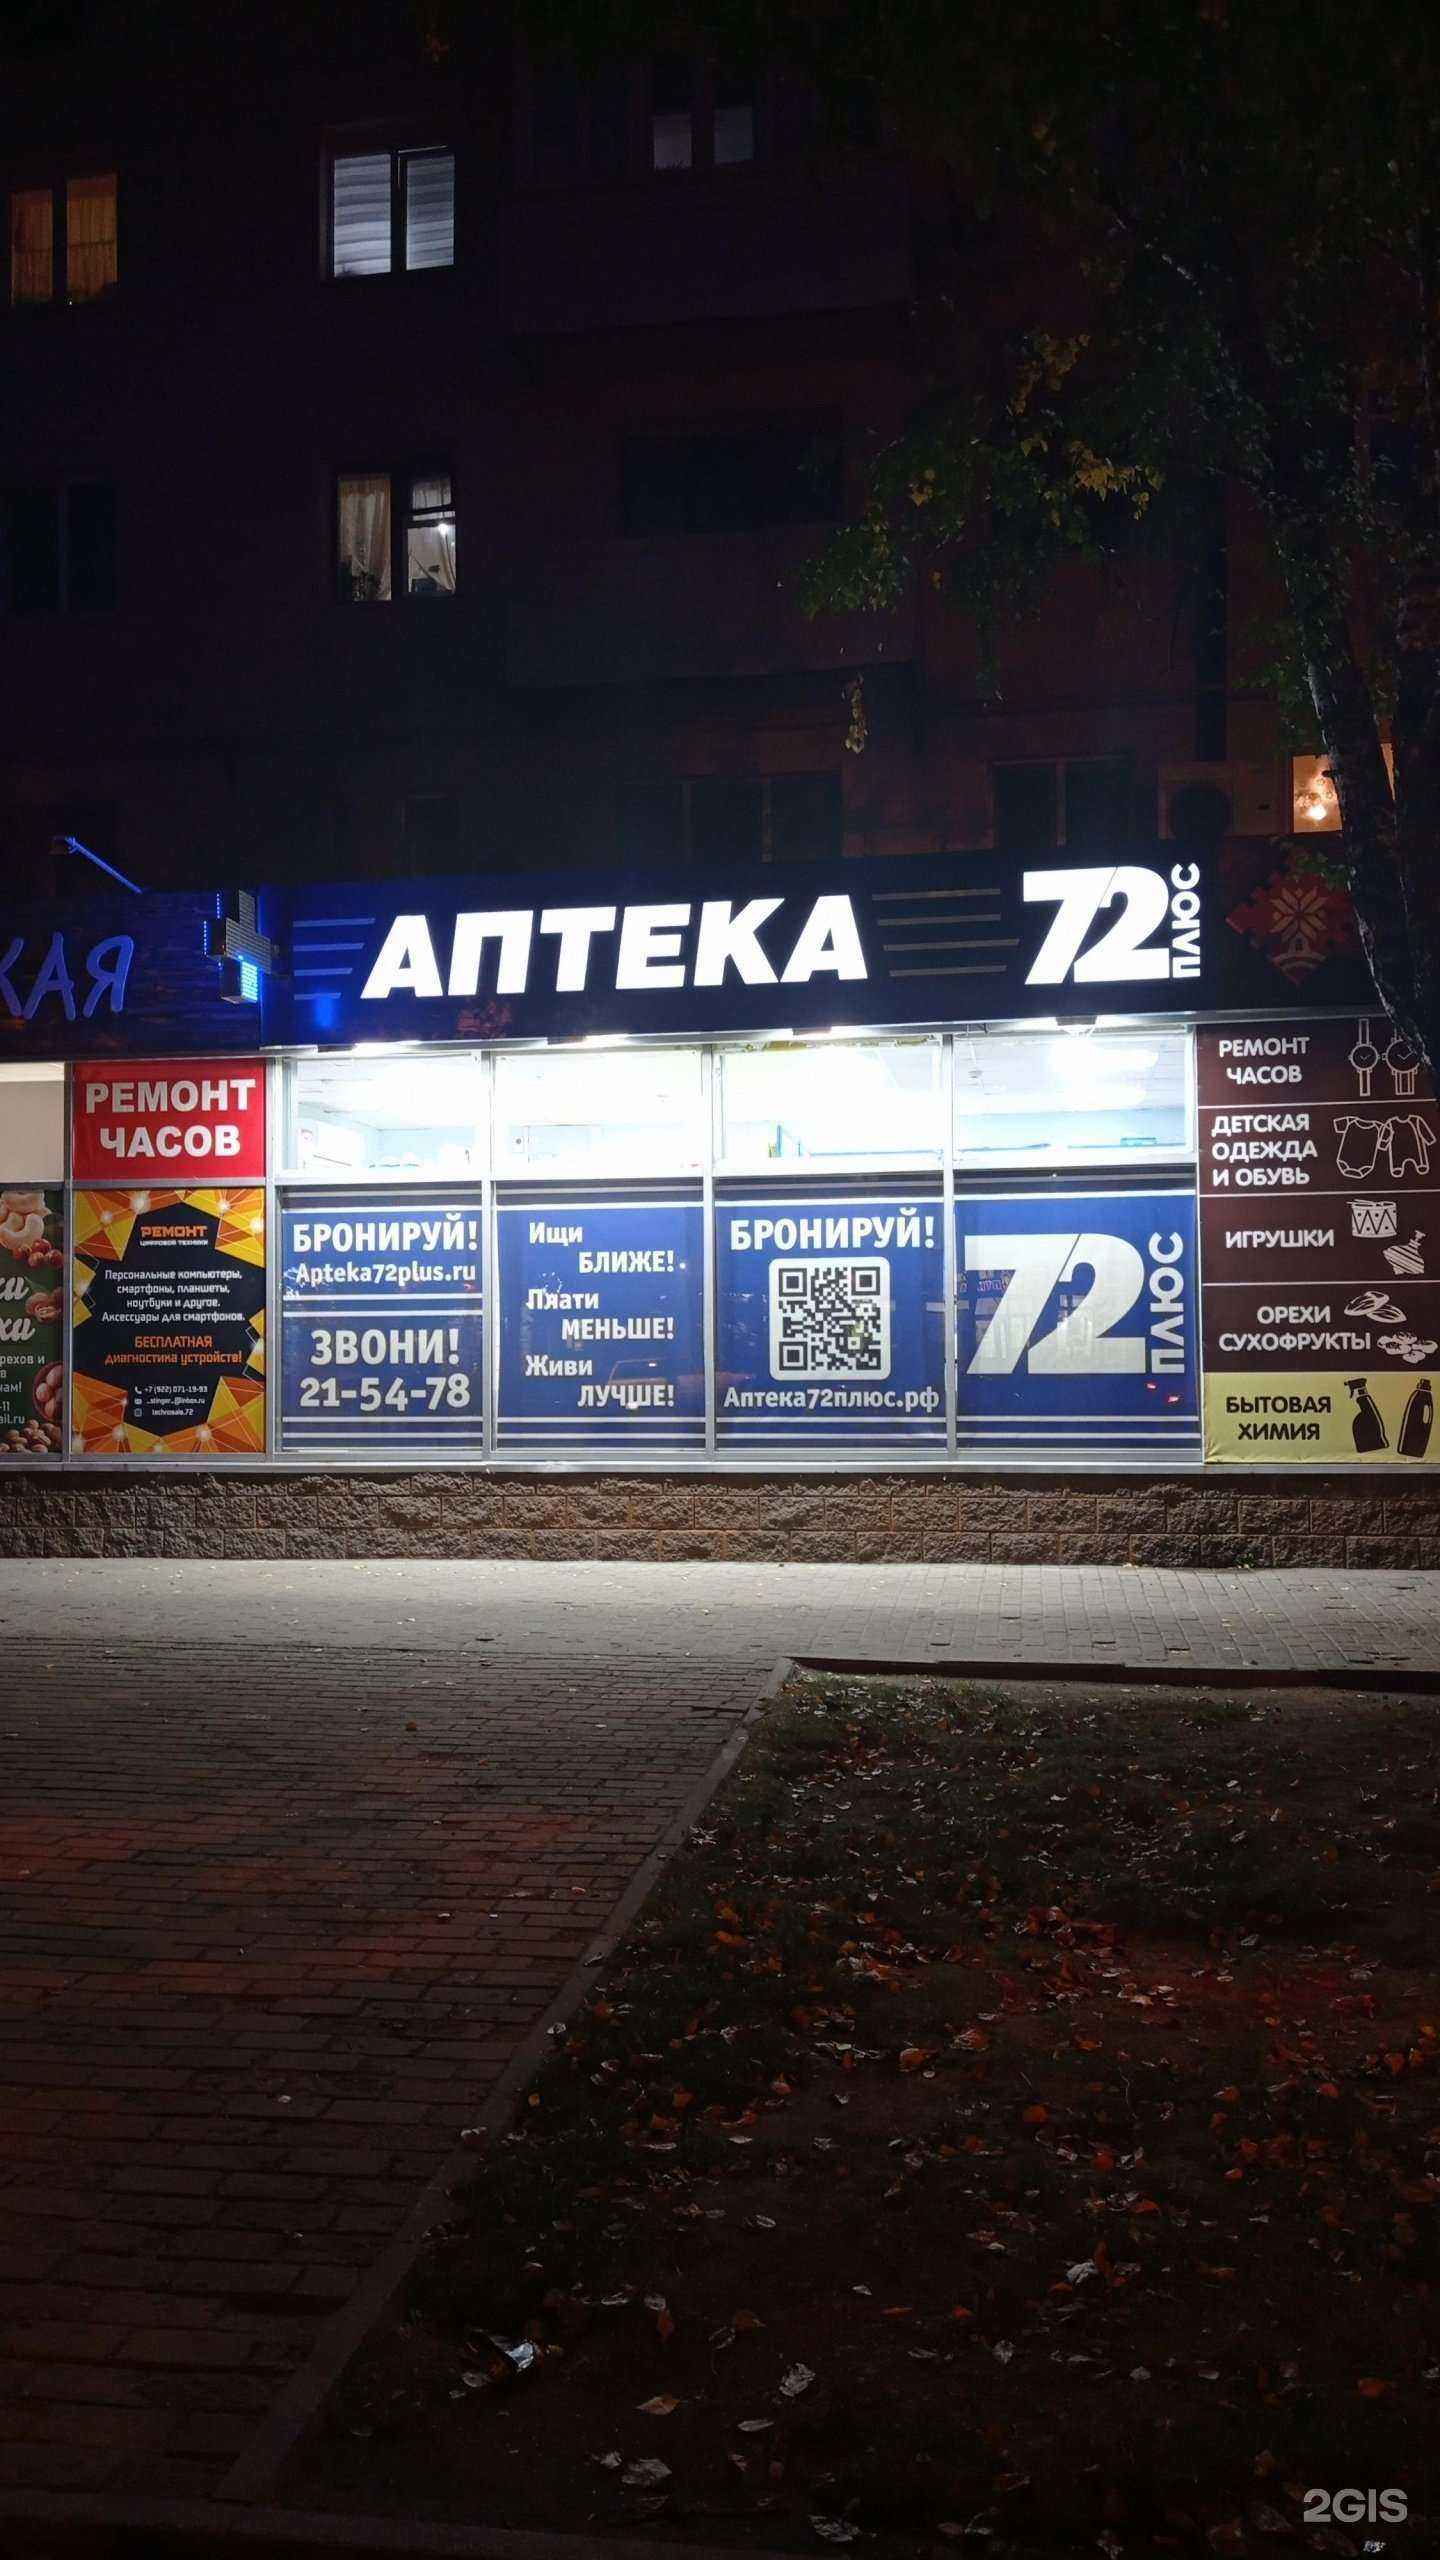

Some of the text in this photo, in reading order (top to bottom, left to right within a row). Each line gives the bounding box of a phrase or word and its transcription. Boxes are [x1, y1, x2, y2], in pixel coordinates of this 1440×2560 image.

[1171, 862, 1200, 978] ПЛЮС
[360, 866, 1170, 999] АПТЕКА 72
[1219, 1037, 1310, 1057] РЕМОНТ
[1226, 1065, 1303, 1085] ЧАСОВ
[86, 1079, 256, 1114] РЕМОНТ
[1211, 1113, 1310, 1137] ДЕТСКАЯ
[101, 1125, 241, 1158] ЧАСОВ
[1211, 1140, 1318, 1163] ОДЕЖДА
[1212, 1167, 1310, 1187] И ОБУВЬ
[140, 1226, 208, 1238] РЕМОНТ
[293, 1212, 478, 1252] БРОНИРУЙ!
[529, 1222, 583, 1246] Ищи
[730, 1207, 935, 1251] БРОНИРУЙ!
[1225, 1229, 1335, 1249] ИГРУШКИ
[578, 1250, 674, 1274] БЛИЖЕ!
[105, 1269, 242, 1281] Персональные компьютеры,
[295, 1261, 476, 1287] Apteka72plus.ru
[117, 1284, 230, 1295] смартфоны, планшеты,
[126, 1298, 172, 1310] ноутбуки
[183, 1300, 221, 1310] другое.
[965, 1233, 1146, 1374] 72
[1149, 1231, 1185, 1374] ПЛЮС
[102, 1312, 245, 1324] Аксессуары для смартфонов.
[1256, 1306, 1331, 1324] ОРЕХИ
[562, 1317, 674, 1340] МЕНЬШЕ!
[134, 1336, 213, 1348] БЕСПЛАТНАЯ
[310, 1328, 459, 1366] ЗВОНИ!
[1218, 1332, 1371, 1351] СУХОФРУКТЫ
[105, 1350, 242, 1366] диагностика устройств!
[525, 1355, 593, 1376] Живи
[299, 1373, 470, 1412] 21-54-78
[577, 1384, 674, 1408] ЛУЧШЕ!
[723, 1386, 940, 1413] Аптека72плюс.рф
[1226, 1396, 1331, 1413] БЫТОВАЯ
[1238, 1423, 1320, 1441] ХИМИЯ
